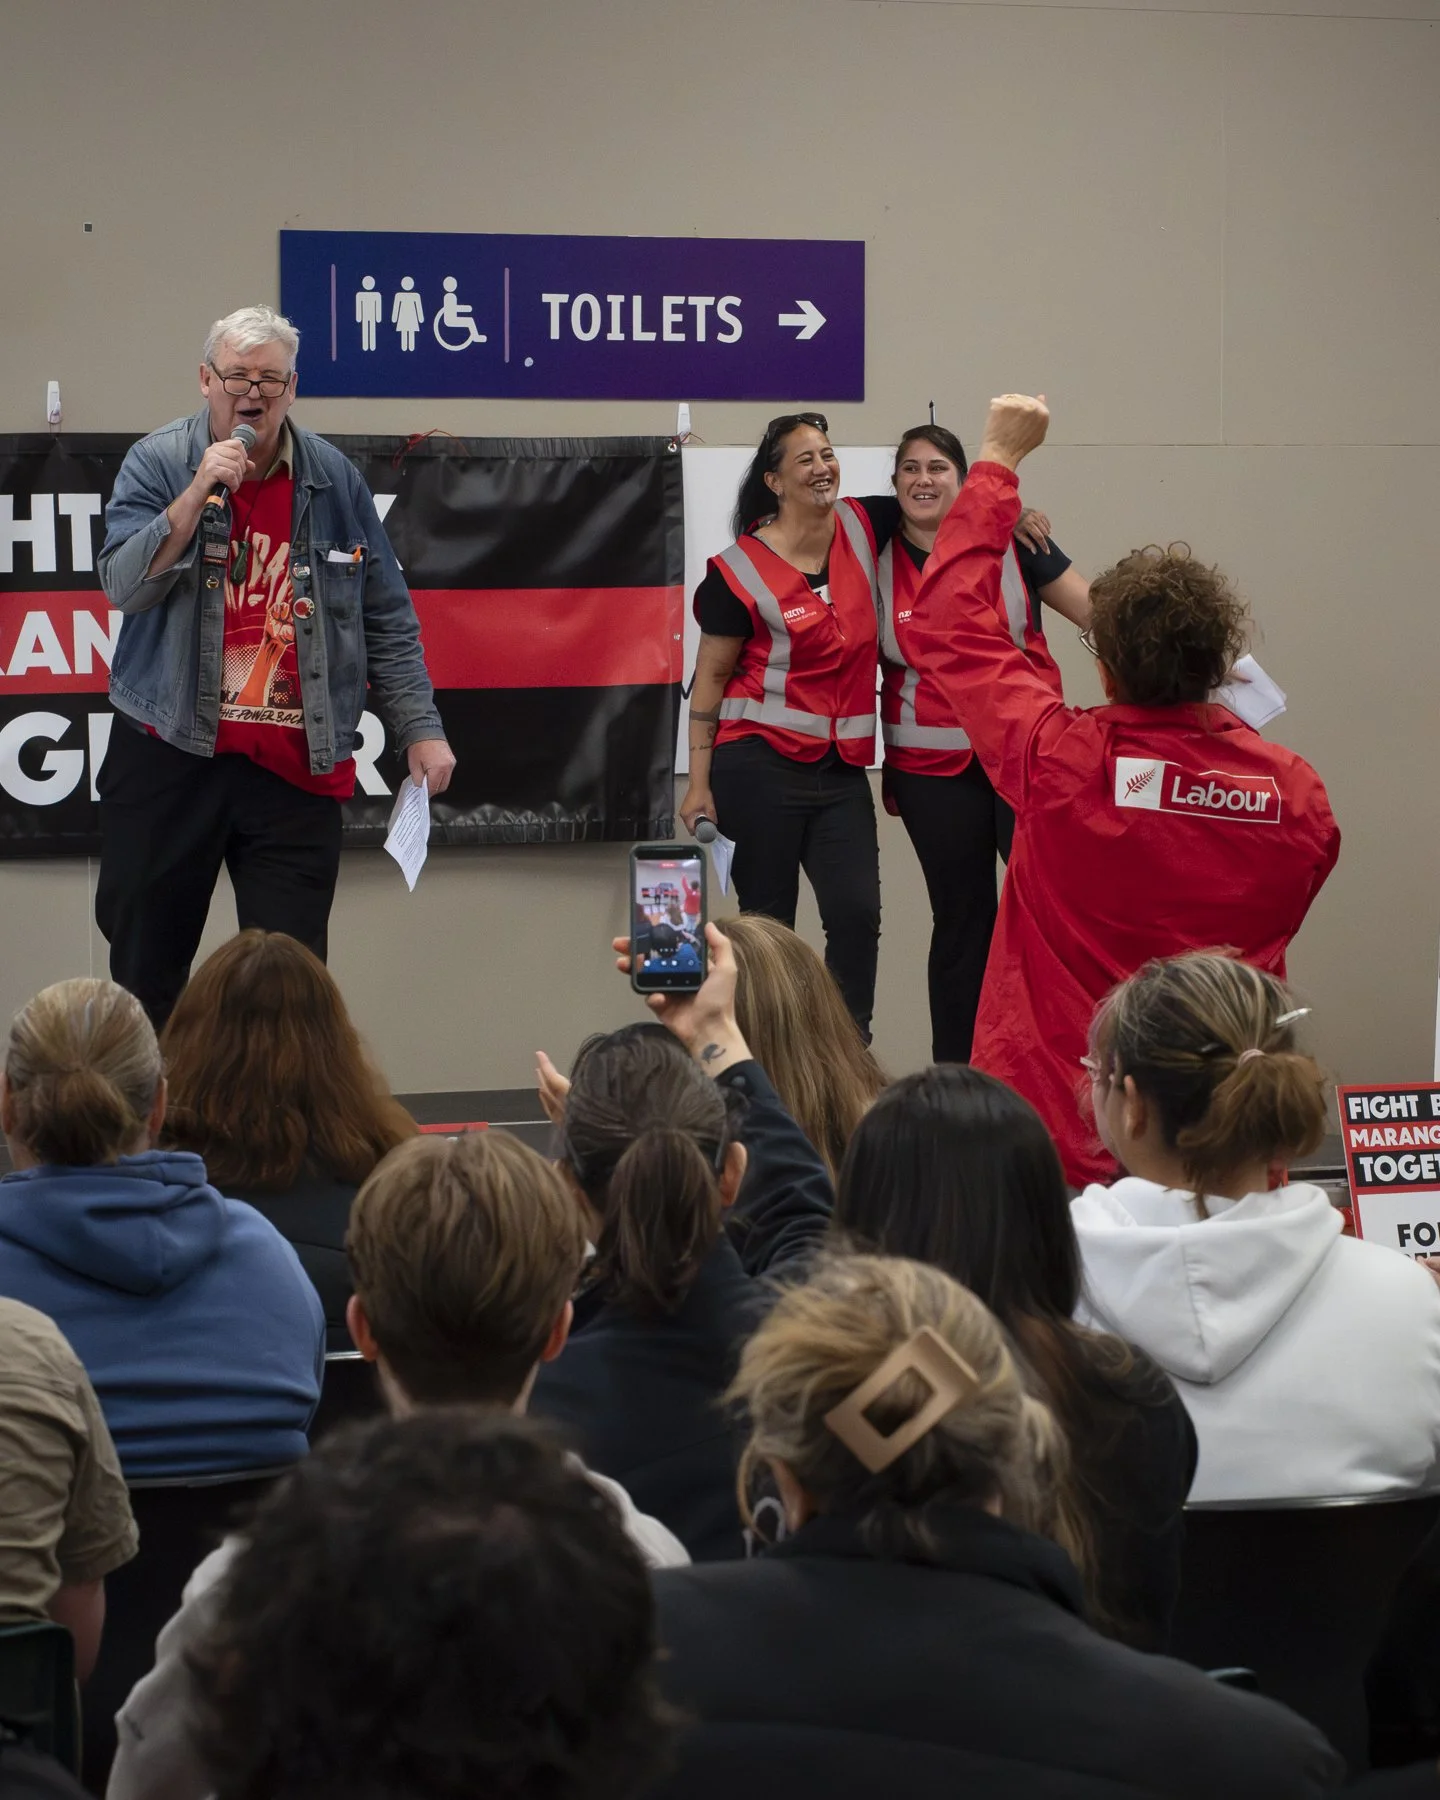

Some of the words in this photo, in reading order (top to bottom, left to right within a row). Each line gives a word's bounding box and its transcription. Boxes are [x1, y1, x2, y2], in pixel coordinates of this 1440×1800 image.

[542, 293, 743, 344] TOILETS
[0, 610, 123, 676] AN
[236, 708, 275, 722] POWER
[1171, 776, 1272, 812] Labour
[1348, 1094, 1419, 1119] FIGHT
[1397, 1222, 1440, 1247] FO
